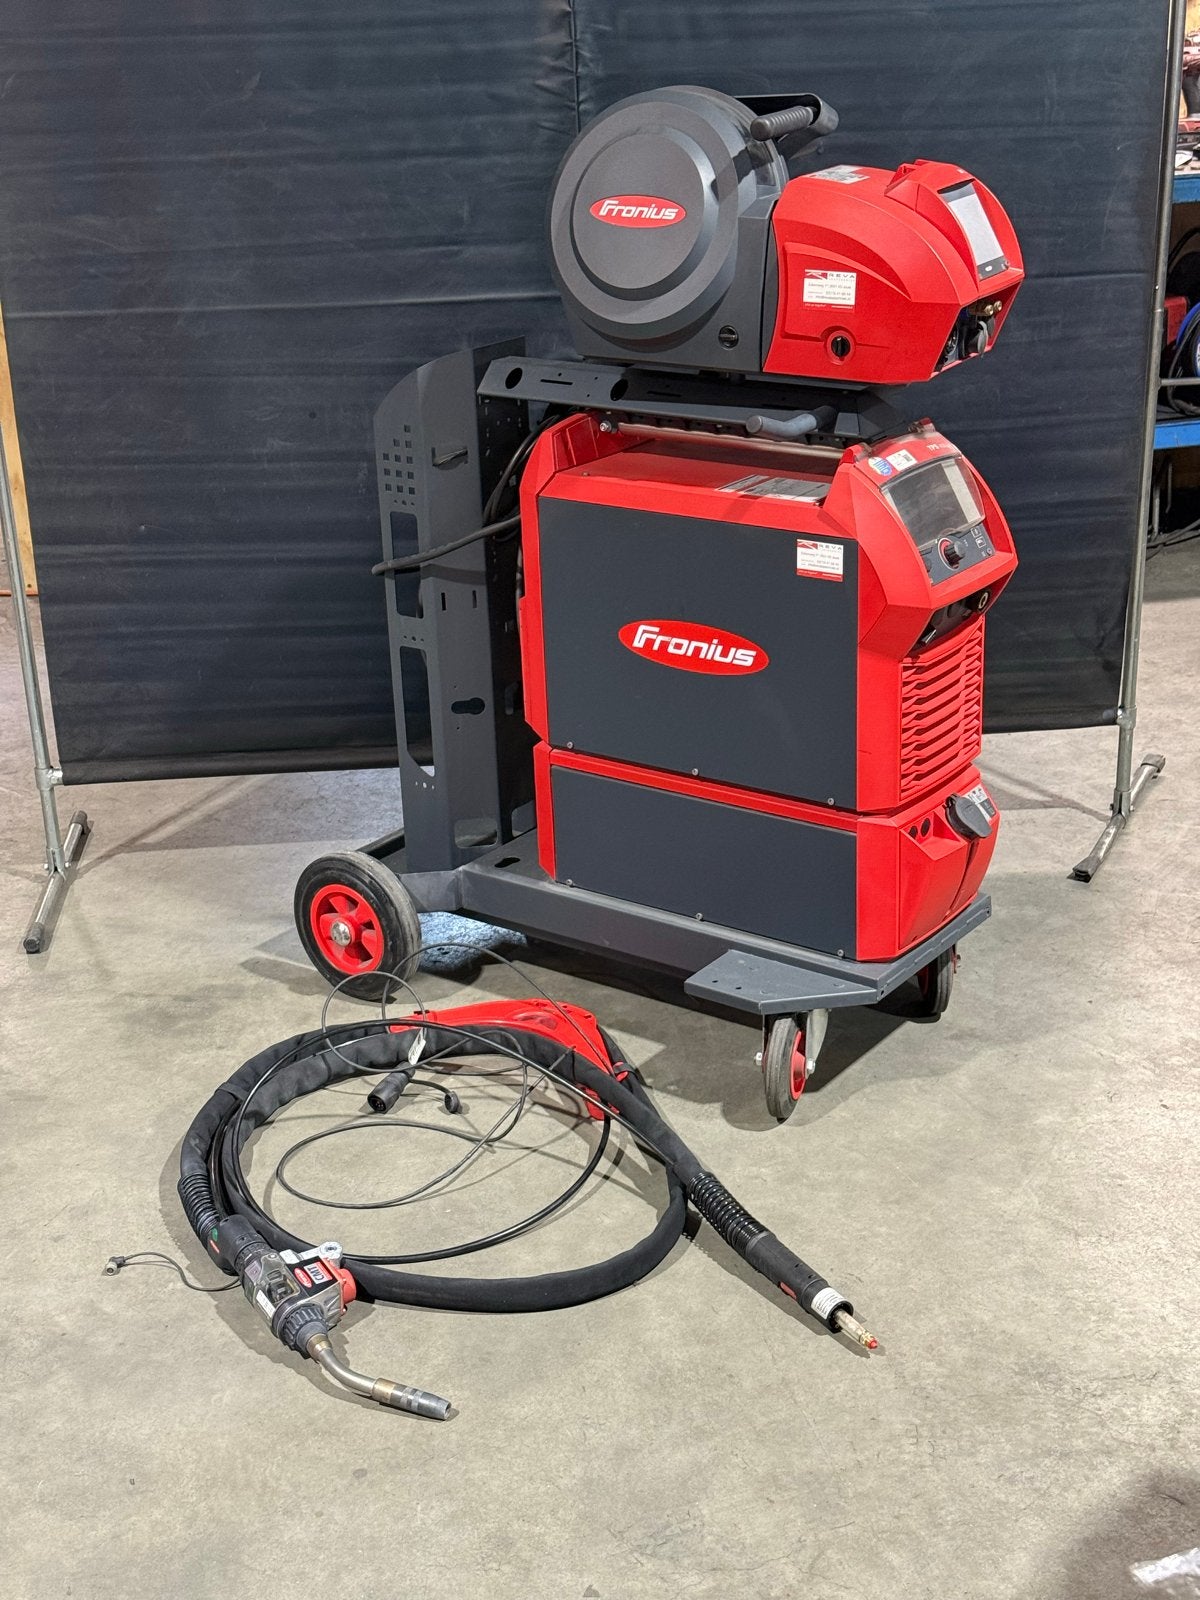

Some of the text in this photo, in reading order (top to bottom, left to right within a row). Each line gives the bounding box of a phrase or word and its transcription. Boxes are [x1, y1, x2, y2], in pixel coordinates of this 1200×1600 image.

[599, 200, 679, 220] Fronius
[818, 543, 842, 551] REVA
[632, 624, 757, 667] Fronius
[307, 1266, 325, 1281] CMT
